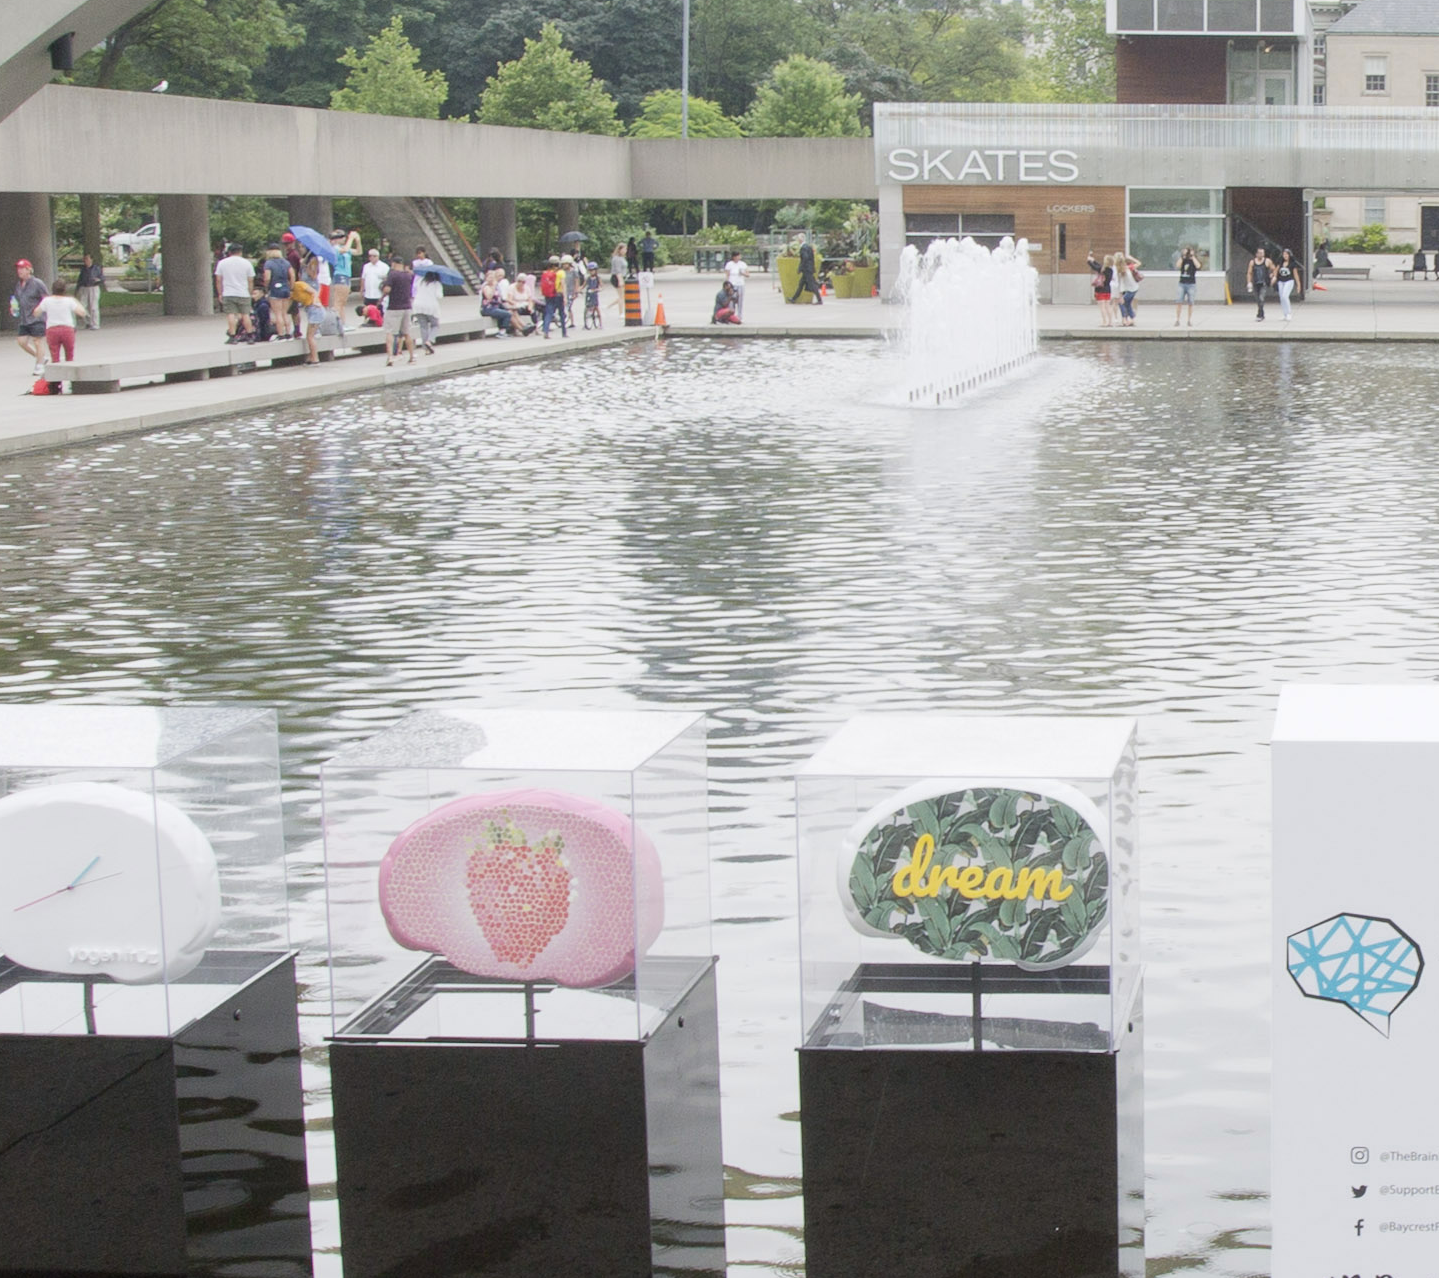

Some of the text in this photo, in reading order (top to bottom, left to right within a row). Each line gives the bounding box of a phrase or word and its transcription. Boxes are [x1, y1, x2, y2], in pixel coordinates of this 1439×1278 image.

[888, 148, 1079, 182] SKATES
[1046, 204, 1096, 214] LOCKERS
[893, 833, 1073, 901] dream
